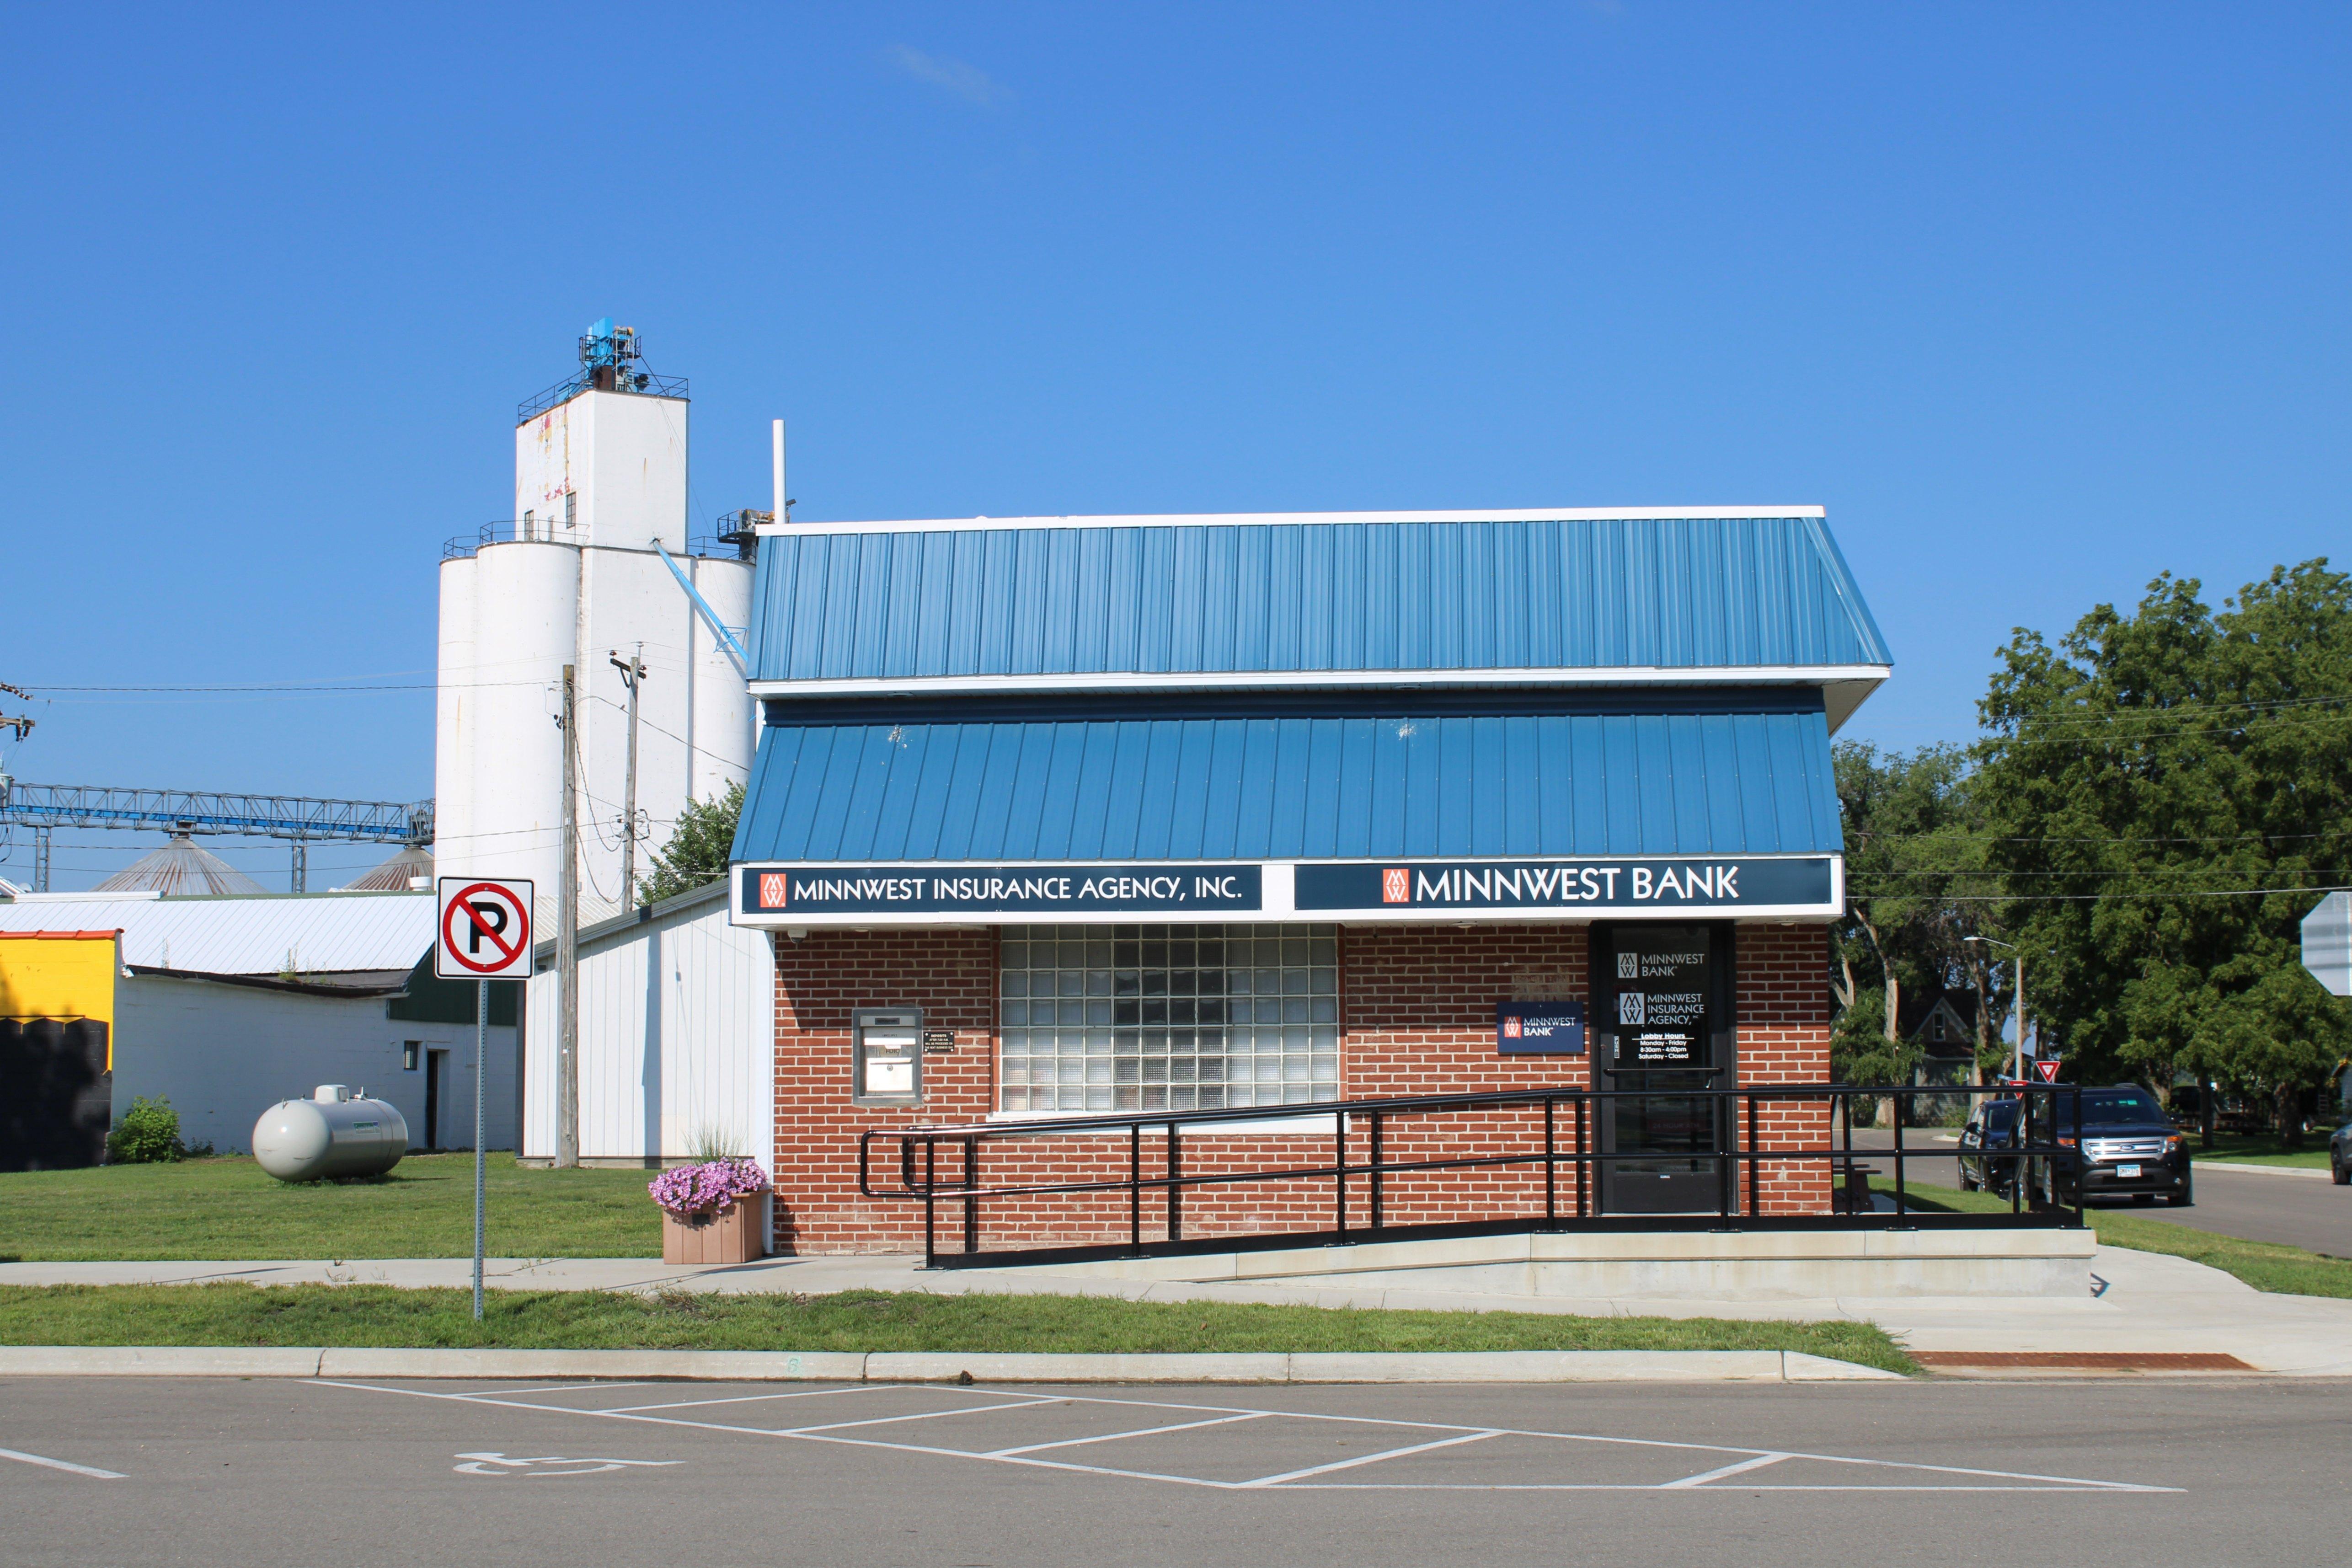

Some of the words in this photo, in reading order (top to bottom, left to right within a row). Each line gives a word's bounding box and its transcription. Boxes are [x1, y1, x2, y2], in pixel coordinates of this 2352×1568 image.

[795, 879, 925, 900] MINNWEST
[934, 878, 1071, 899] INSURANCE
[1078, 877, 1186, 901] AGENCY,
[1195, 876, 1242, 898] INC.
[1416, 868, 1620, 901] MINNWEST
[1642, 954, 1705, 964] MINNWEST
[1647, 994, 1702, 1003] MINNWEST
[1647, 1005, 1704, 1014] INSURANCE
[1523, 1017, 1576, 1026] MINNWEST
[1648, 1015, 1692, 1025] AGENCY,
